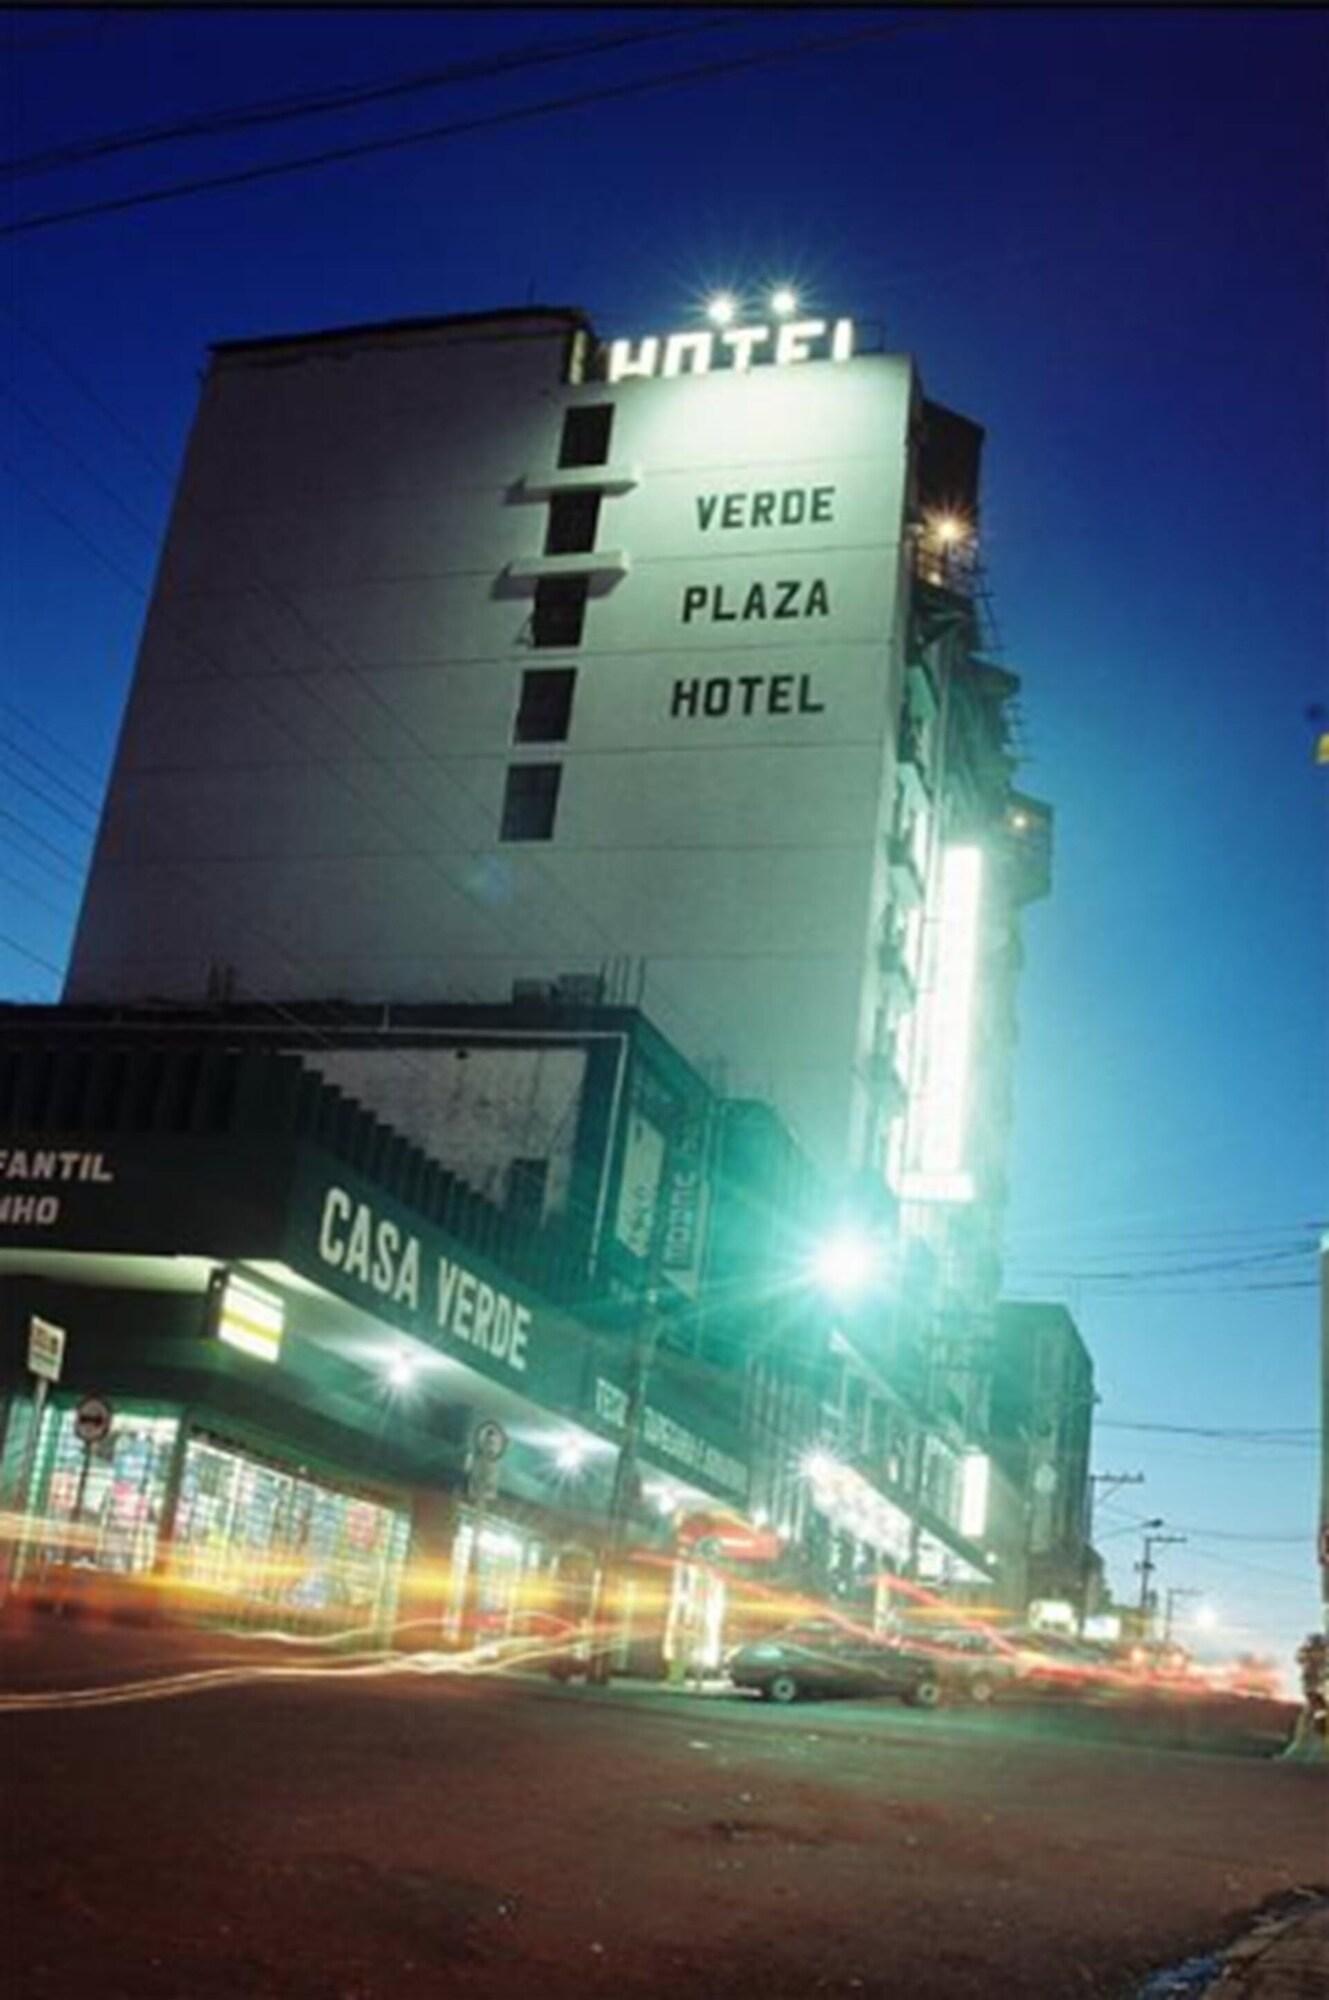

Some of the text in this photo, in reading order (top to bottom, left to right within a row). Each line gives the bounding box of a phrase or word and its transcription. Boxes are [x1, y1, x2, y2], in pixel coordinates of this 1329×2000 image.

[696, 486, 836, 531] VERDE
[682, 579, 830, 623] PLAZA
[670, 674, 825, 718] HOTEL
[318, 1186, 533, 1372] CASA VERDE
